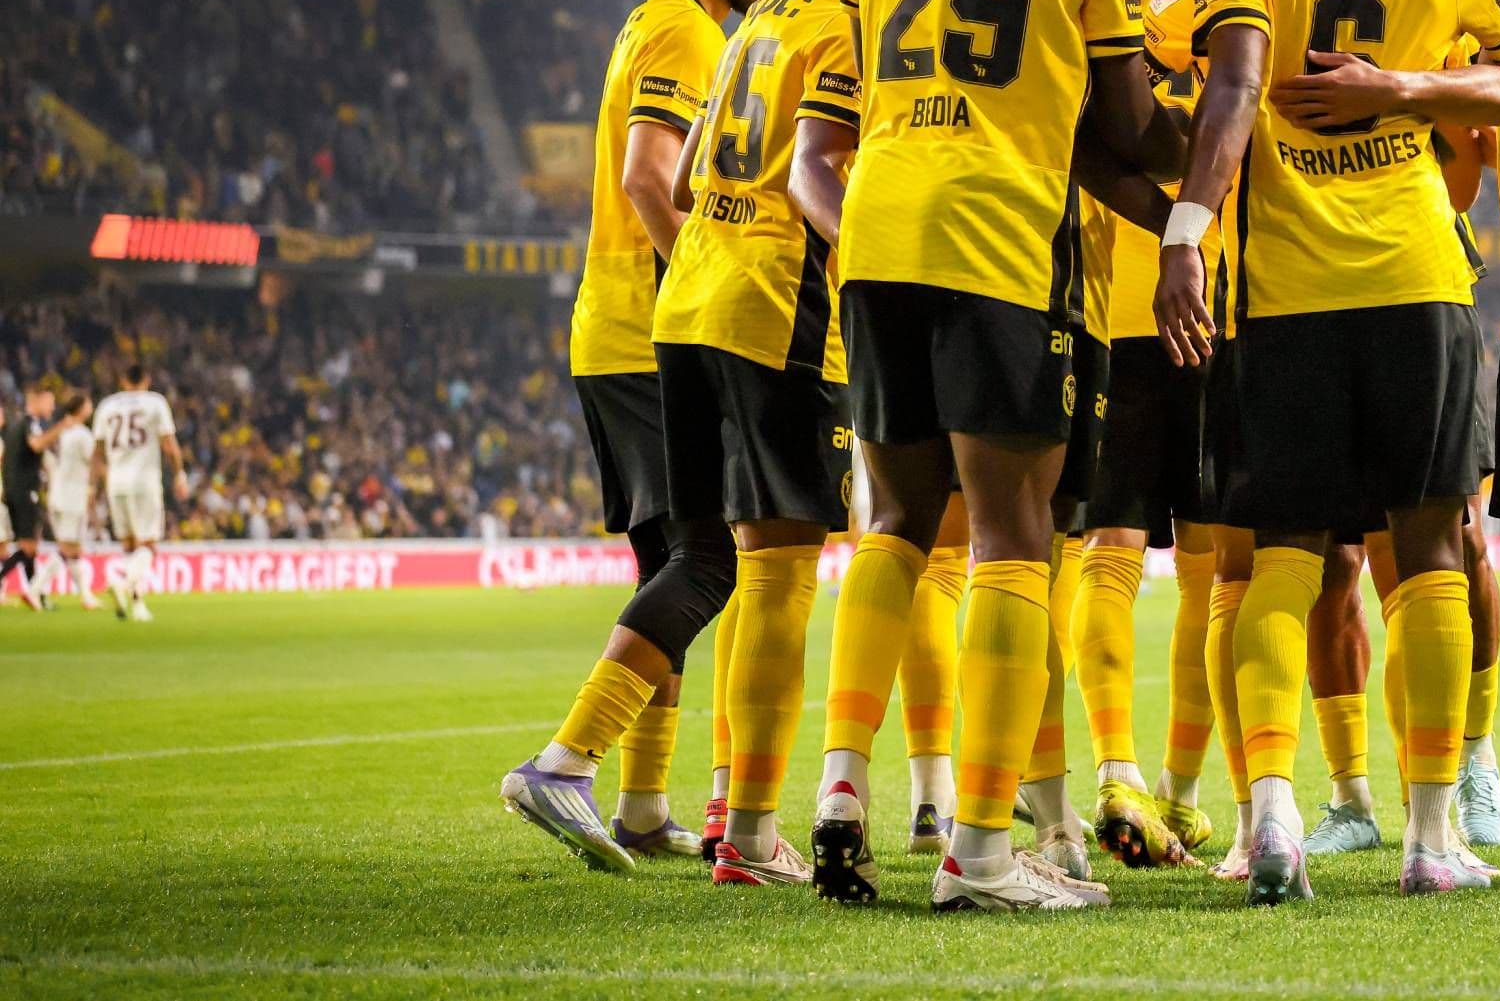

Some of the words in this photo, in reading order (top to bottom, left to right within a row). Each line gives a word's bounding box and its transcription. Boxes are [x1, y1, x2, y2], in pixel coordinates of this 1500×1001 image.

[910, 95, 971, 128] BEDIA
[1277, 130, 1422, 177] FERNANDES
[201, 553, 397, 592] ENGAGIERT
